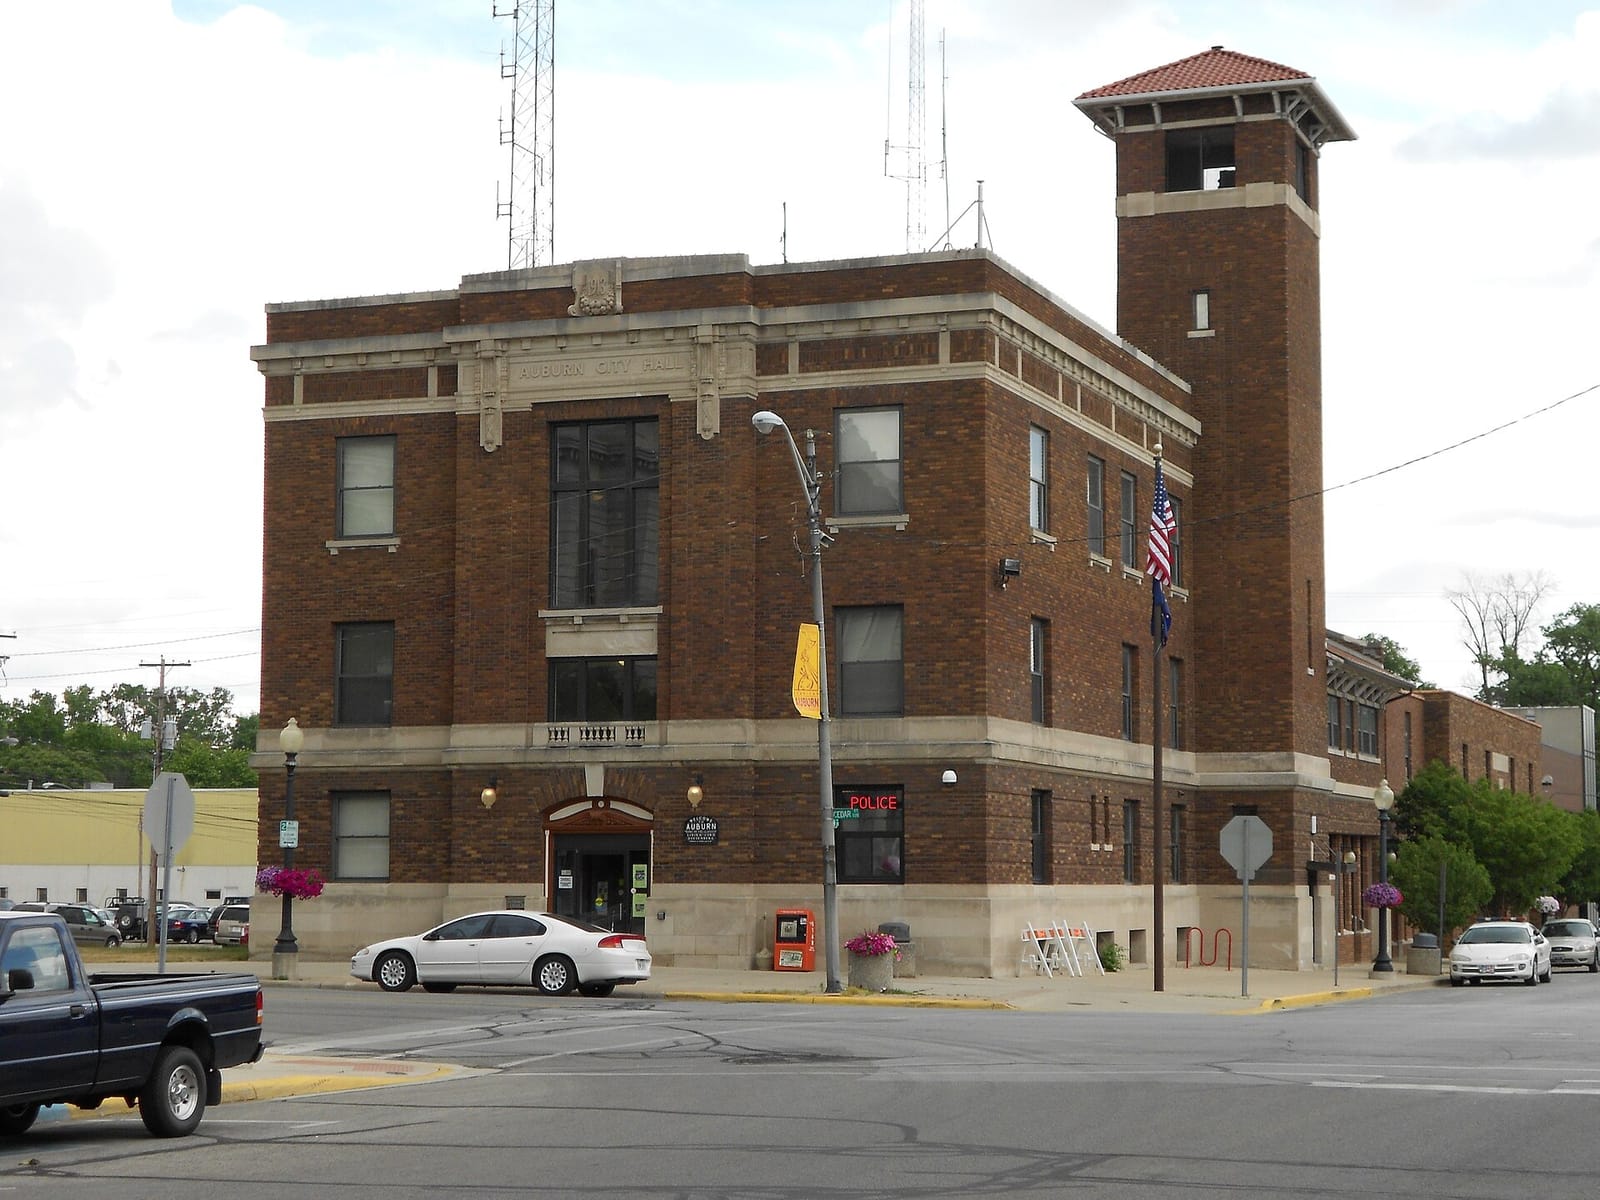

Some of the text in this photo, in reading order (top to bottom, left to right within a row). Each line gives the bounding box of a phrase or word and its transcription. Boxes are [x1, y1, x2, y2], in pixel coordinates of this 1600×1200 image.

[519, 355, 684, 379] AUBURN CITY HALL
[850, 796, 897, 810] POLICE
[833, 810, 852, 819] CEDAR
[686, 822, 717, 831] AUBURN
